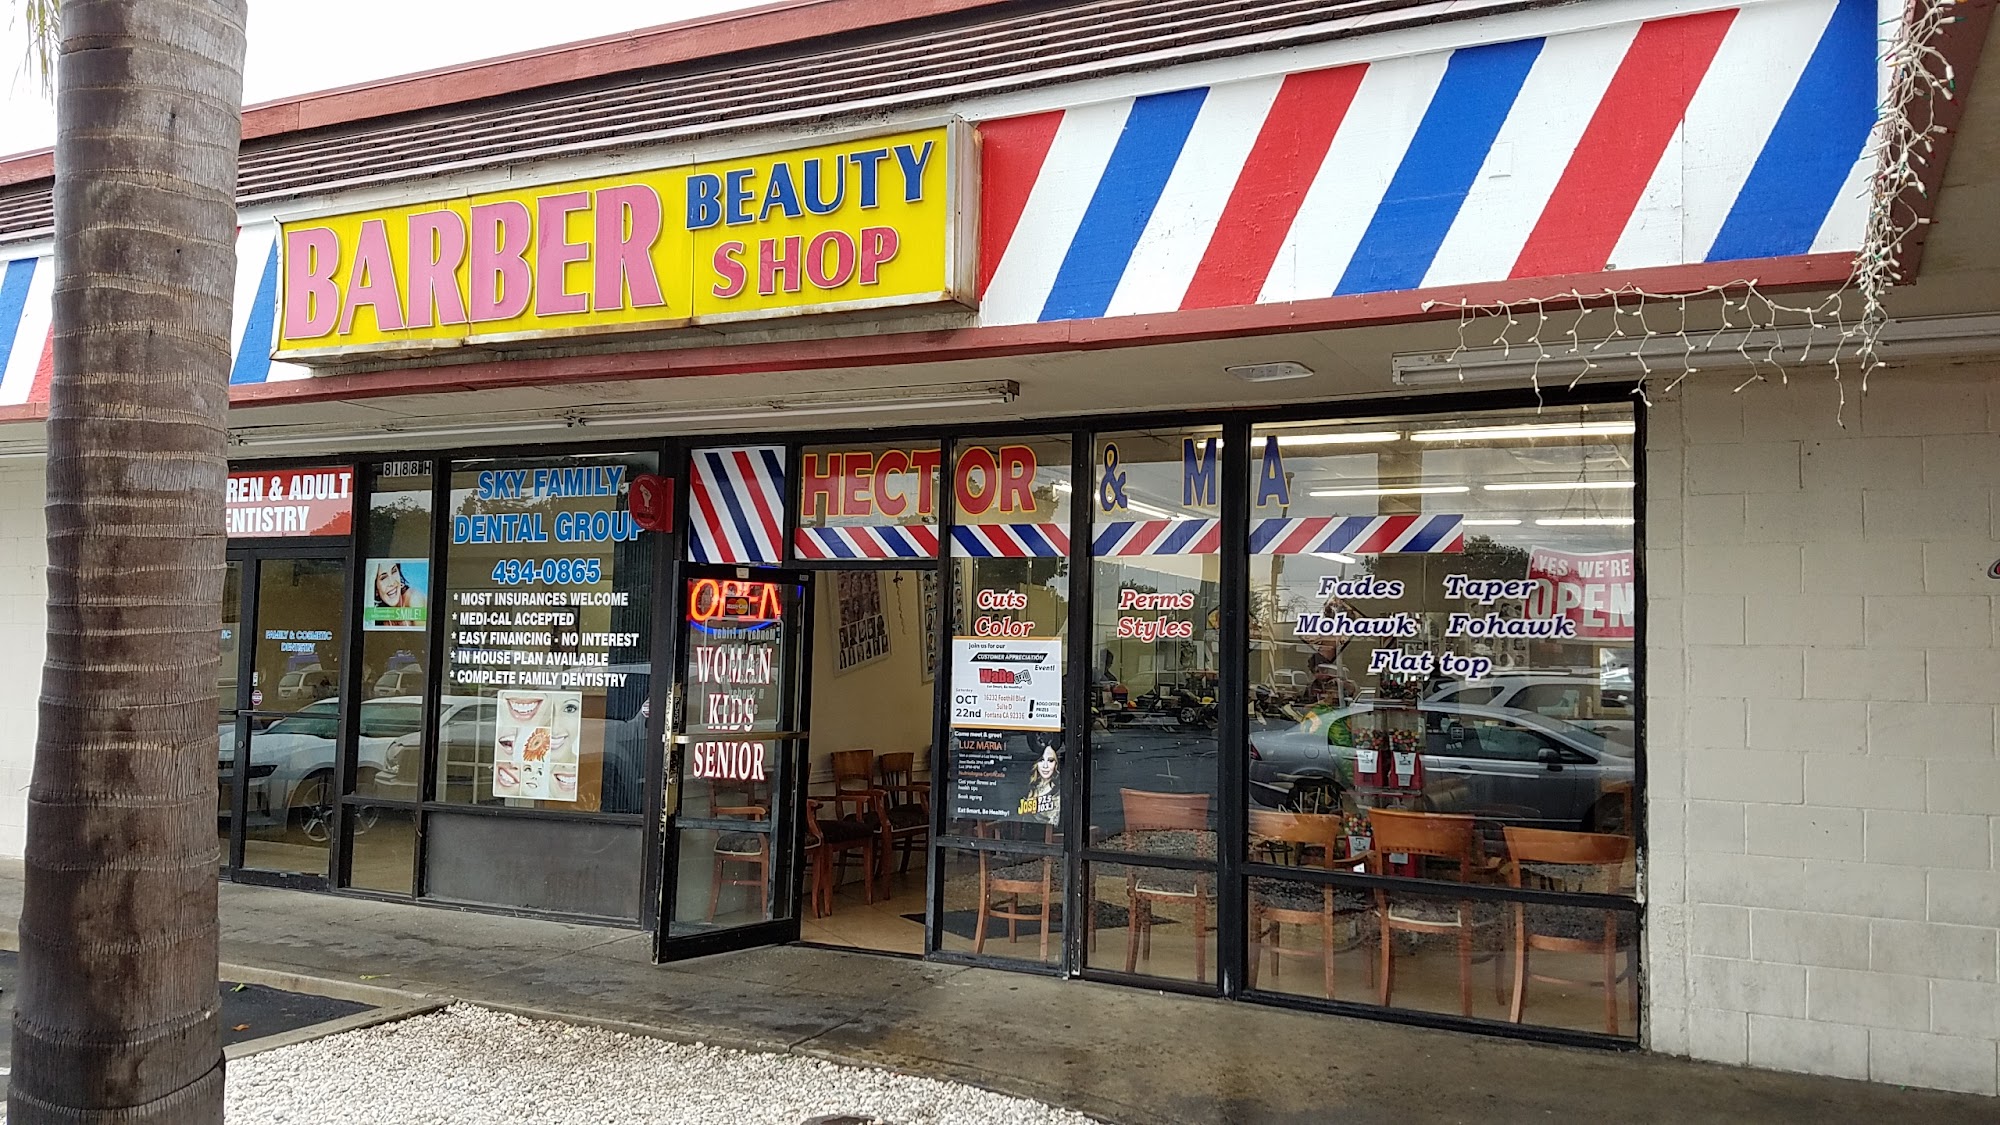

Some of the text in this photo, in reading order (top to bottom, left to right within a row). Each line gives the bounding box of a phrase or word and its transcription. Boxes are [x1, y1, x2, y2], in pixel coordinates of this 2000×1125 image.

[686, 140, 934, 231] BEAUTY
[284, 184, 667, 339] BARBER
[712, 226, 899, 298] SHOP
[383, 461, 418, 477] 8188
[802, 445, 1037, 517] HECTOR
[1100, 442, 1128, 515] &
[268, 476, 283, 501] &
[288, 473, 351, 500] ADULT
[478, 465, 625, 500] SKY FAMILY
[453, 510, 646, 544] DENTAL GROUP
[491, 558, 602, 585] 434-0865
[1539, 555, 1631, 578] YES WE'RE
[461, 592, 628, 606] MOST INSURANCES WELCOME
[977, 589, 1027, 610] Cuts
[1118, 589, 1195, 610] Perms
[1316, 574, 1539, 606] Fades Taper
[1528, 578, 1634, 627] OPEN
[459, 612, 575, 626] MEDI-CAL ACCEPTED
[975, 616, 1035, 637] Color
[1117, 616, 1193, 643] Styles
[1294, 612, 1577, 638] Mohawk Fohawk
[459, 631, 487, 645] EASY
[489, 632, 552, 646] FINANCING
[561, 633, 579, 646] NO
[581, 632, 639, 647] INTEREST
[458, 651, 609, 666] IN HOUSE PLAN AVAILABLE
[696, 647, 773, 684] WOMAN
[1004, 653, 1045, 661] APPRECIATION
[1369, 649, 1492, 683] Flat top
[457, 670, 627, 687] COMPLETE FAMILY DENTISTRY
[707, 694, 754, 732] KIDS
[955, 695, 978, 705] OCT
[955, 708, 981, 718] 22nd
[959, 740, 975, 749] LUZ
[976, 741, 1002, 751] MARIA
[693, 741, 765, 781] SENIOR
